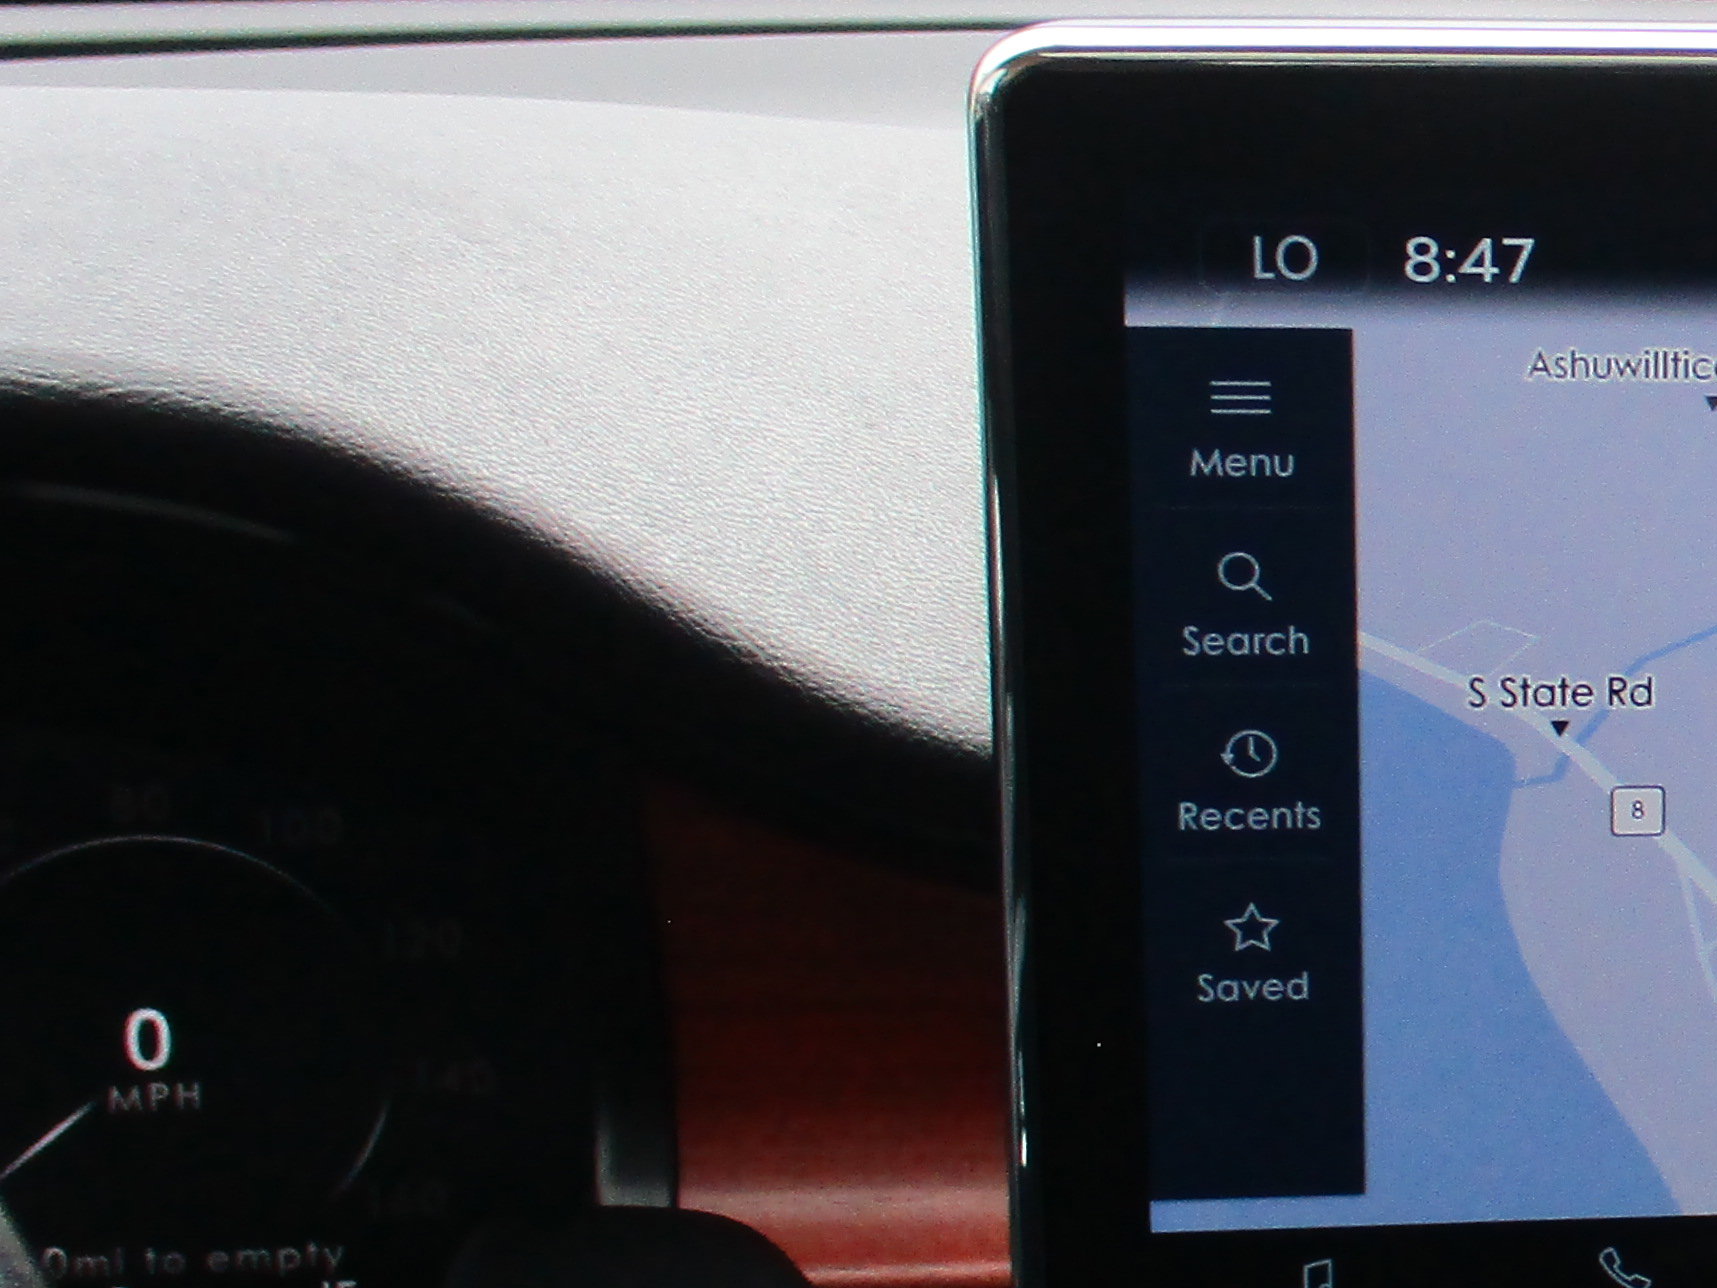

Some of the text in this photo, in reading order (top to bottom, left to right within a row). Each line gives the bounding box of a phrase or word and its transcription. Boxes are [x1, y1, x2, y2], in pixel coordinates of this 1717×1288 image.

[1253, 234, 1318, 281] LO
[1404, 236, 1535, 284] 8:47
[1190, 448, 1295, 478] Menu
[1182, 625, 1310, 657] Search
[1469, 676, 1652, 708] S State Rd
[1178, 801, 1321, 831] Recents
[1631, 799, 1645, 820] 8
[1197, 971, 1309, 1003] Saved
[124, 1006, 173, 1072] 0
[107, 1080, 203, 1113] MPH
[145, 1246, 187, 1273] to
[206, 1239, 345, 1278] empty
